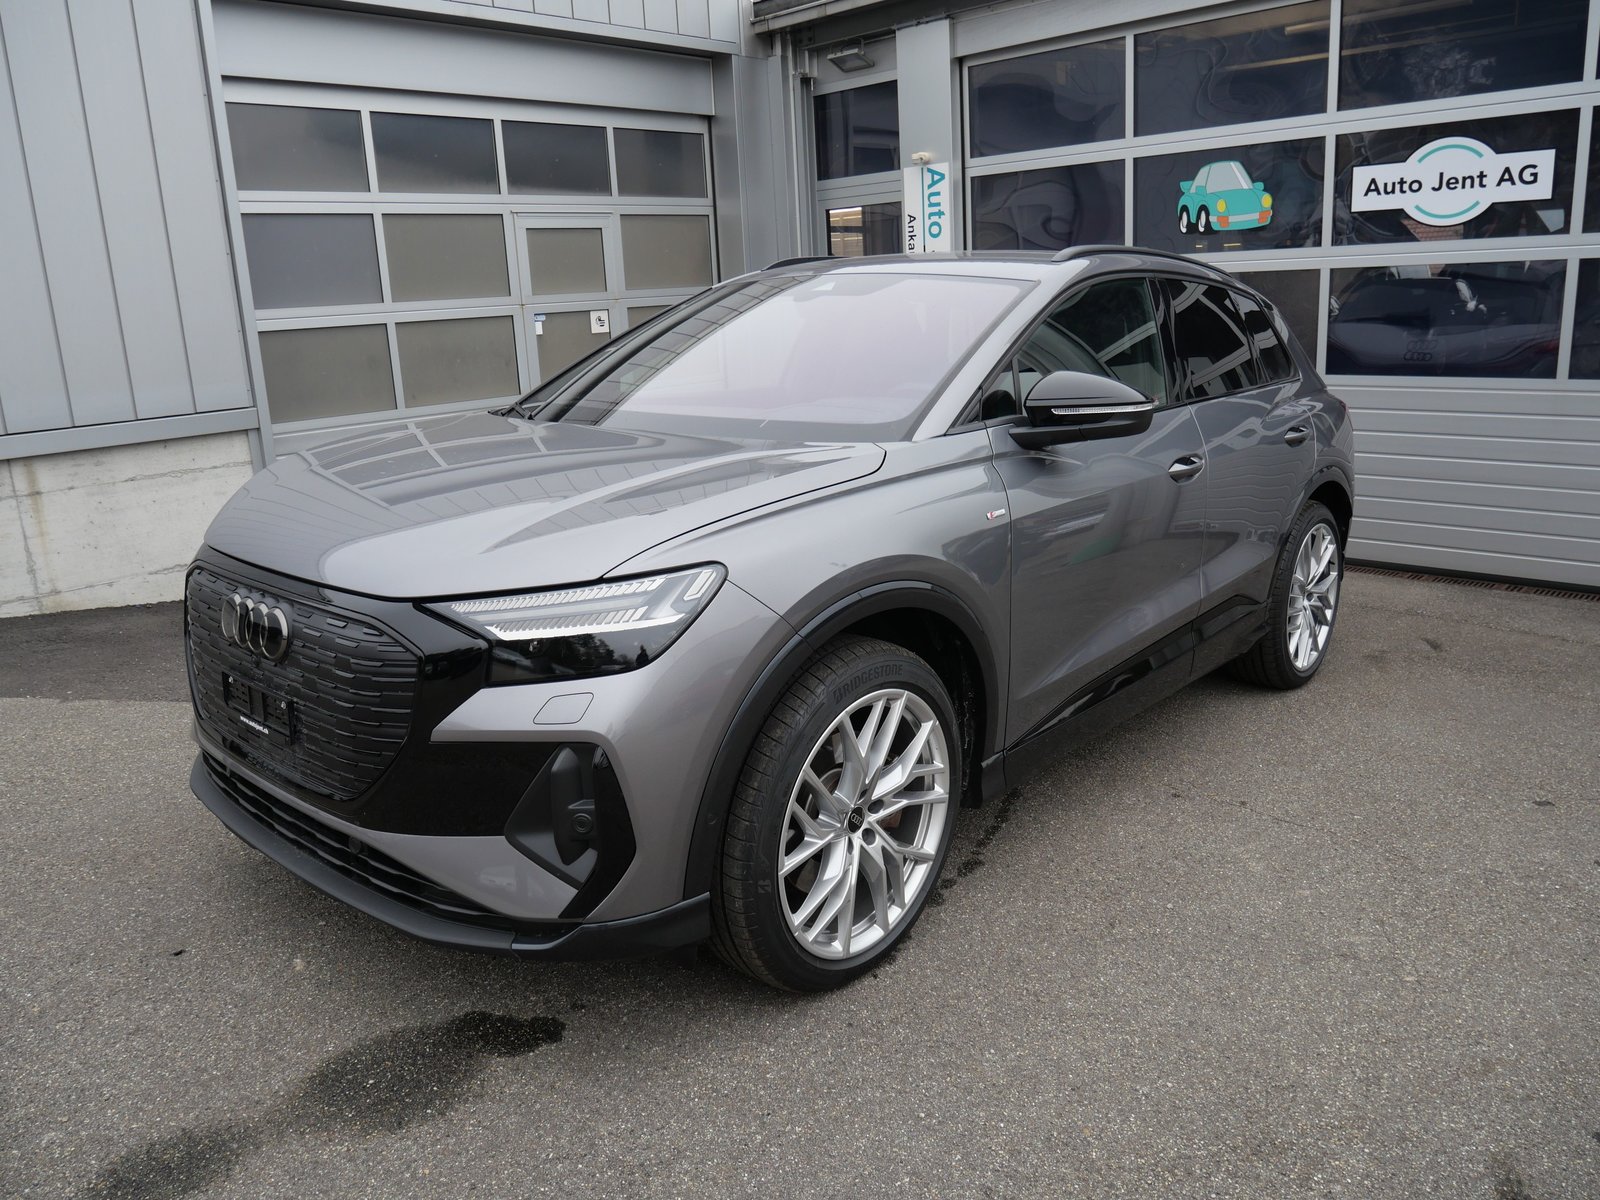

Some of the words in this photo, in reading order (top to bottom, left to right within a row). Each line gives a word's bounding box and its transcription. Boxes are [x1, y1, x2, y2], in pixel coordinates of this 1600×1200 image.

[1363, 177, 1423, 197] Auto
[1431, 171, 1488, 192] Jent
[1496, 164, 1539, 187] AG
[926, 167, 946, 239] Auto
[907, 214, 917, 254] Anka
